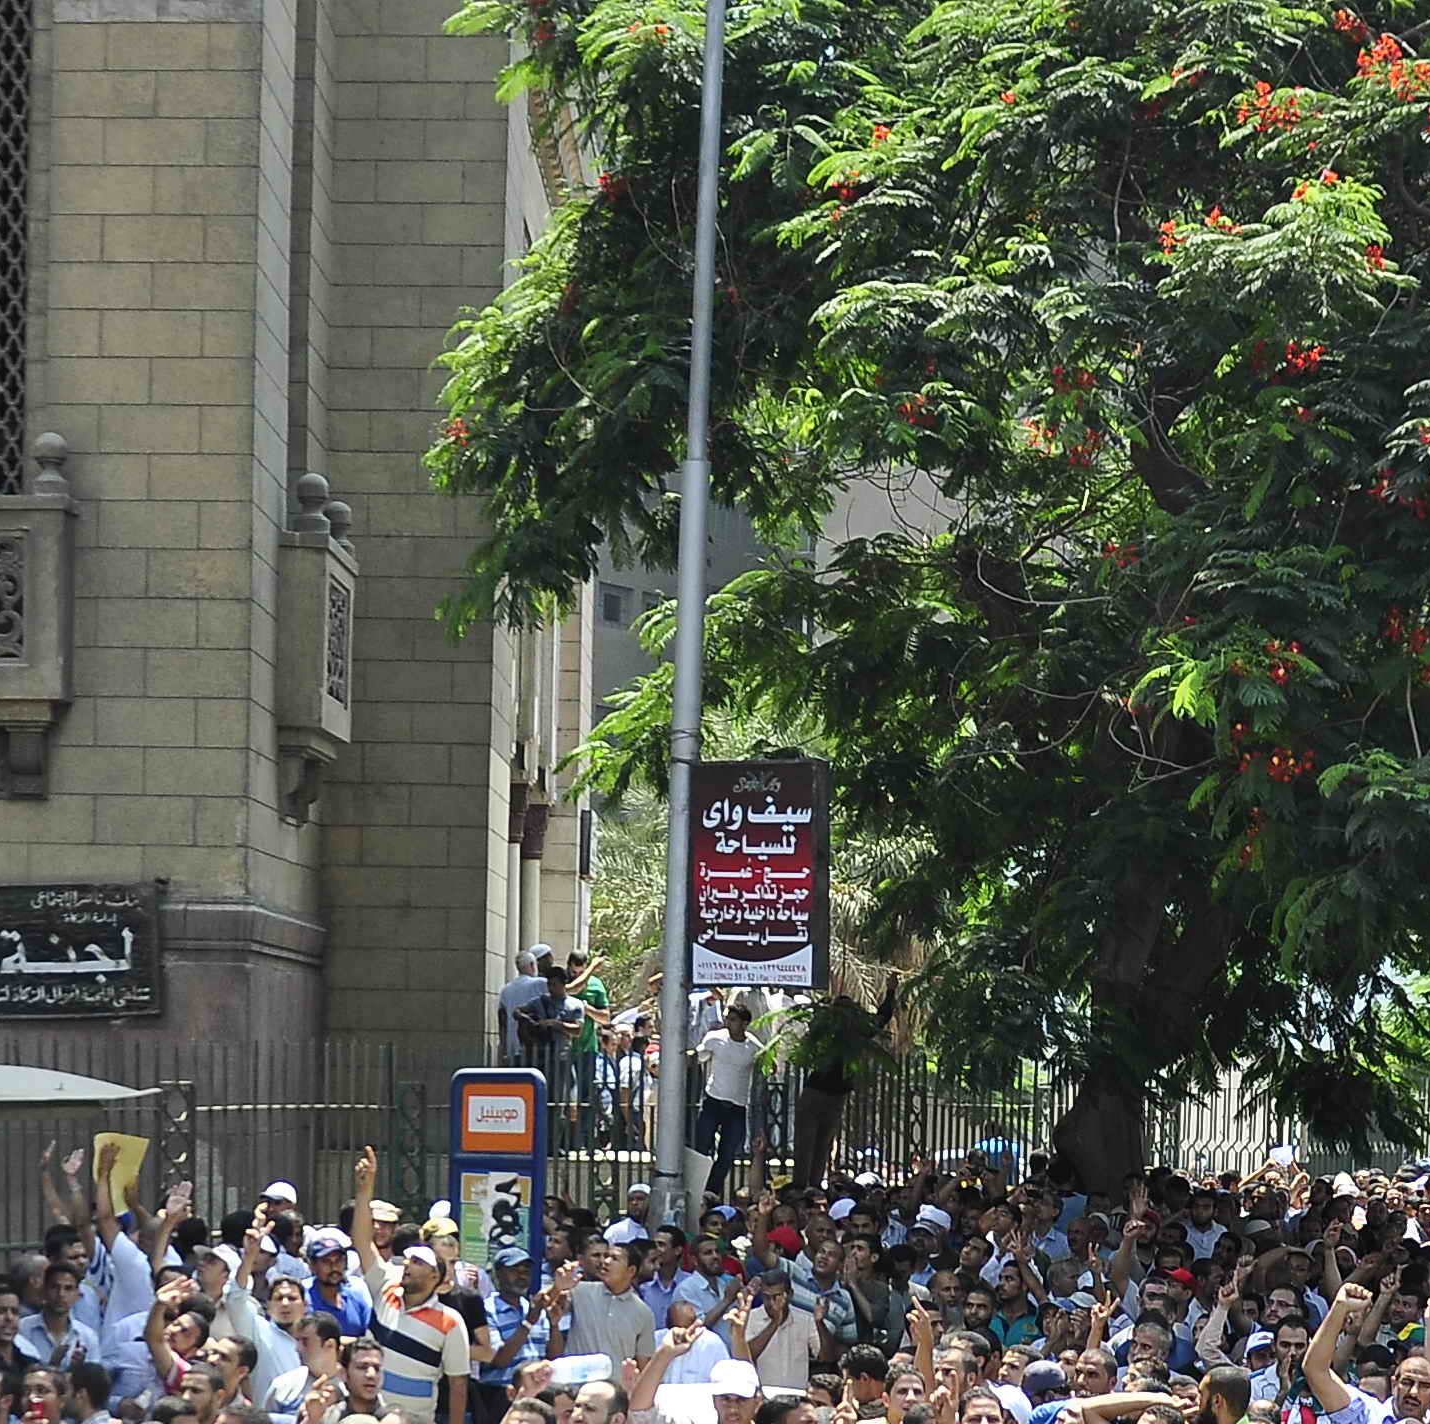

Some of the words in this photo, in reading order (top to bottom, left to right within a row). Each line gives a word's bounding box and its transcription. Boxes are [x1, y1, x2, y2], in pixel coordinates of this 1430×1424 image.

[746, 795, 813, 833] سيف
[714, 831, 797, 860] للسياحة
[698, 883, 739, 904] طيران
[739, 882, 778, 903] تذاكر
[778, 884, 810, 904] حجز
[698, 902, 742, 925] وخارجية
[743, 903, 775, 925] داخلية
[776, 903, 809, 926] سياحة
[475, 1105, 519, 1123] موبينيل
